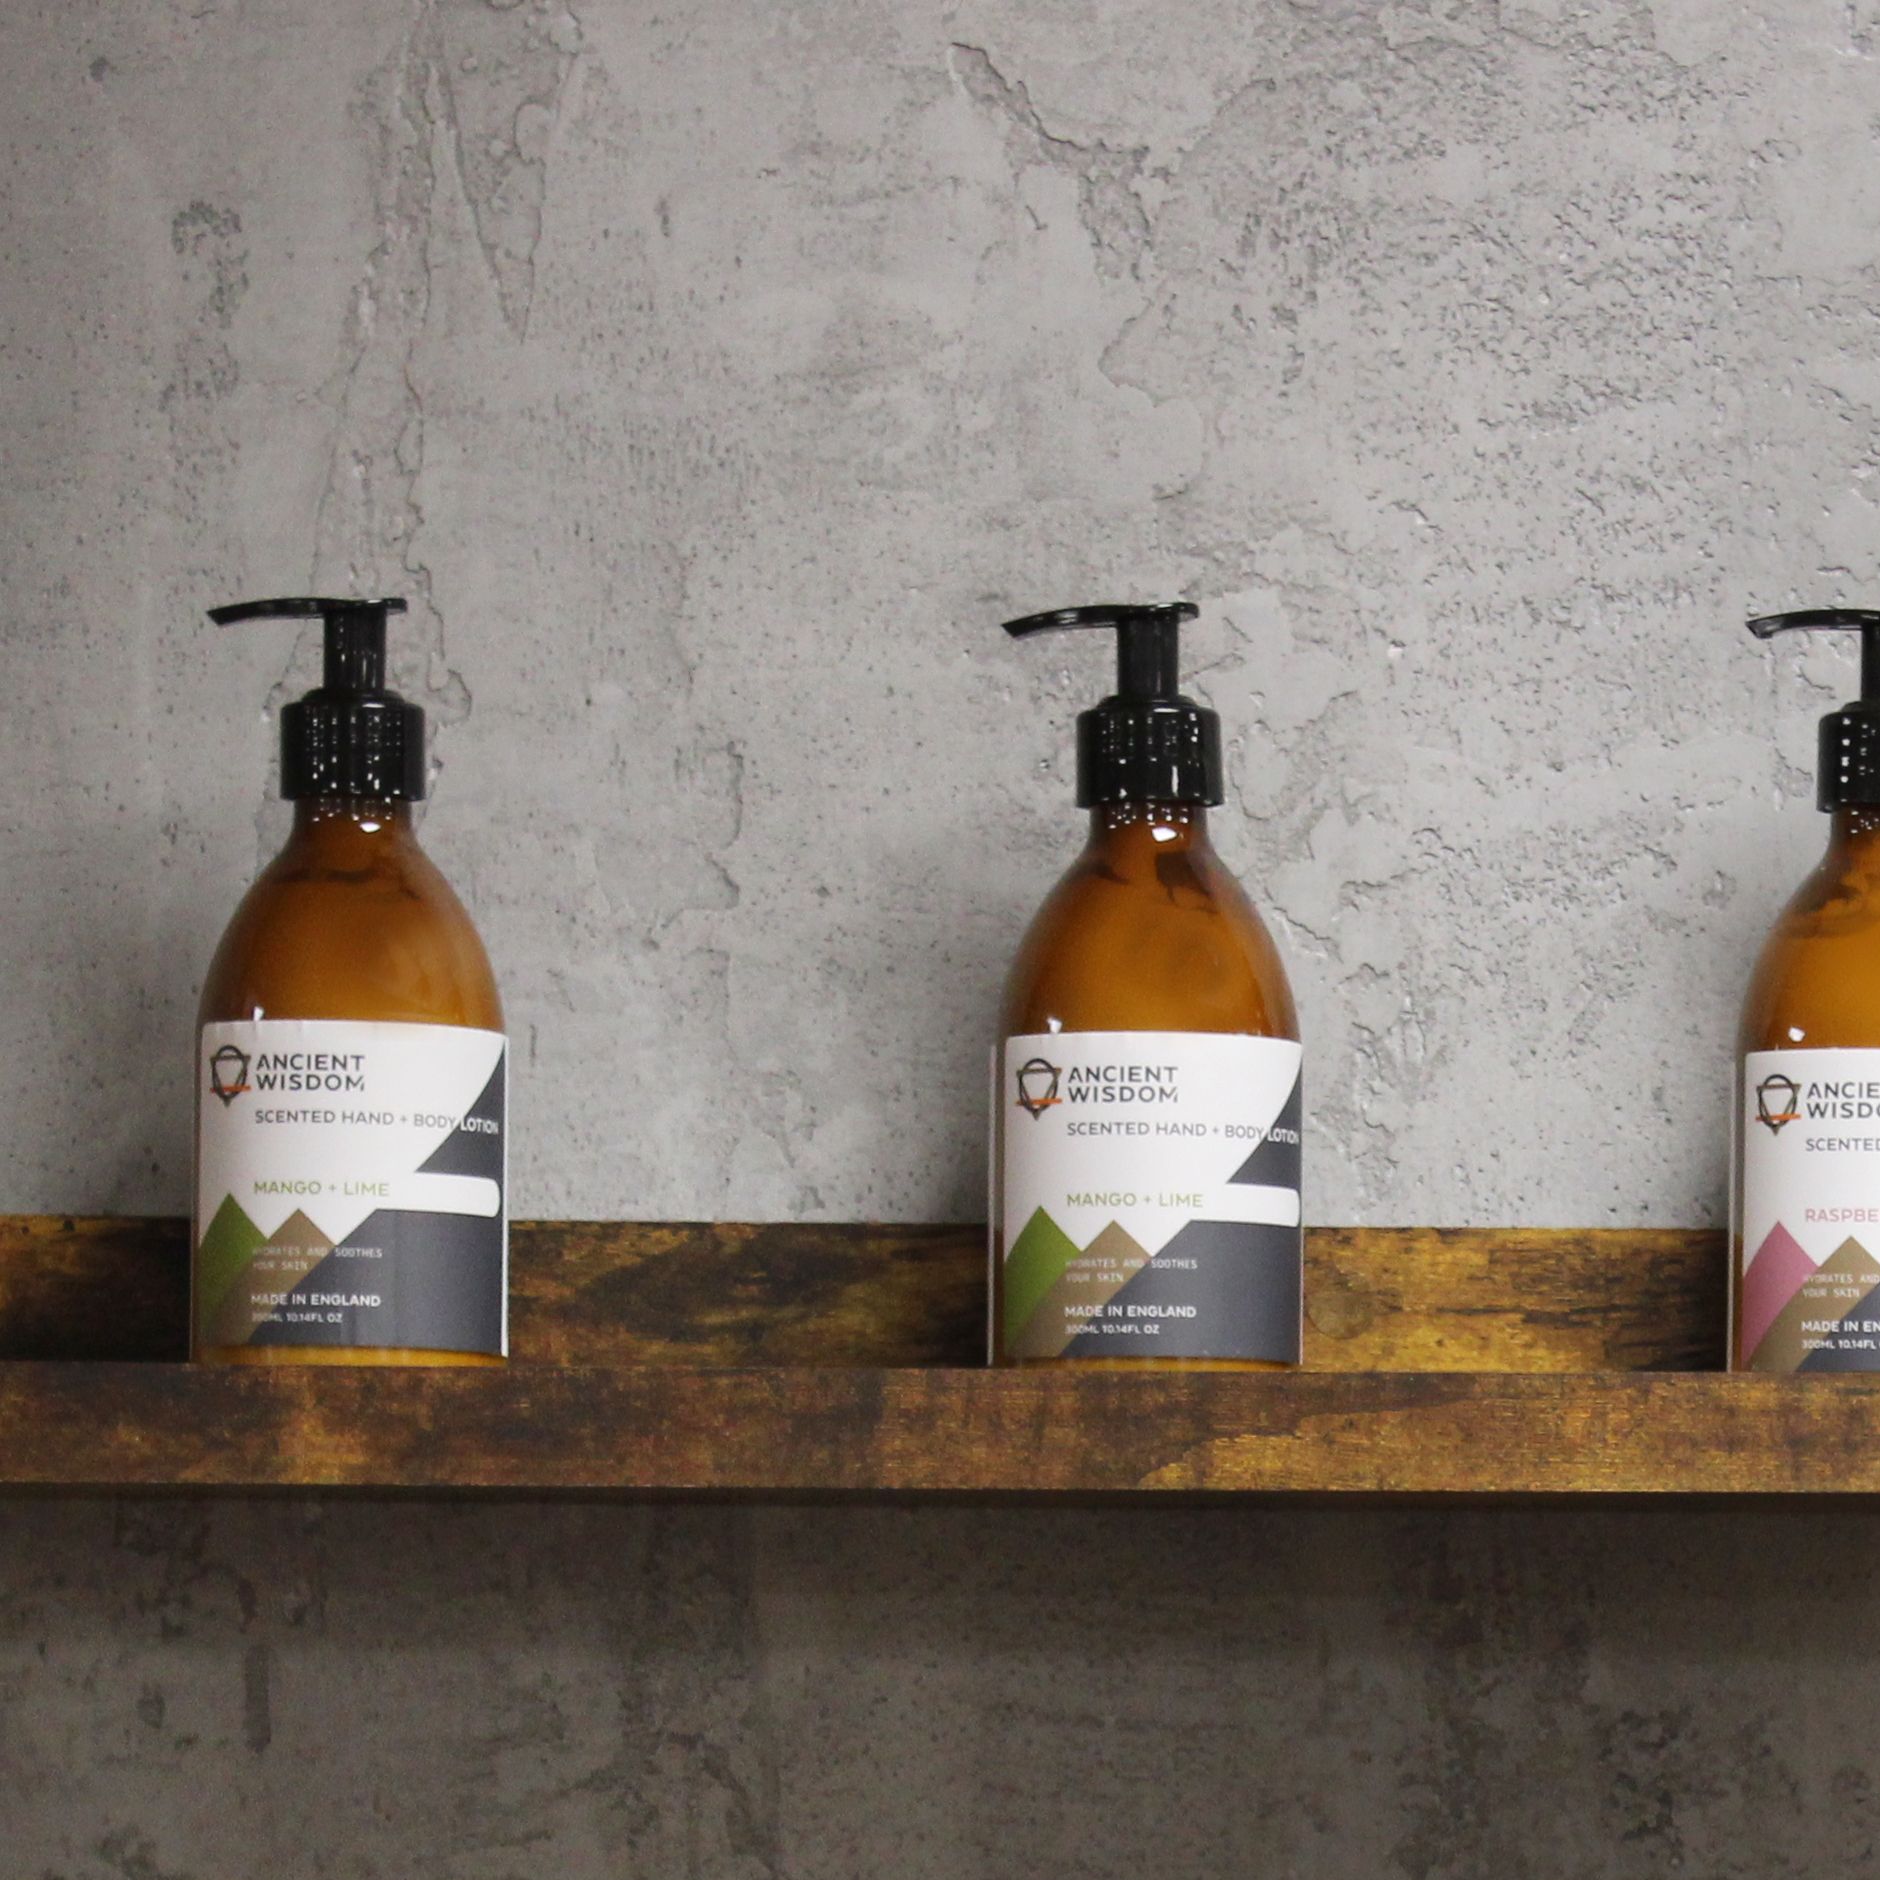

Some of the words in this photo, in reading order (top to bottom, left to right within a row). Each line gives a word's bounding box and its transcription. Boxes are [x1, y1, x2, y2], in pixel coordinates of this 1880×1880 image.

[256, 1054, 366, 1071] ANCIENT
[257, 1074, 365, 1091] WISDOM
[1068, 1066, 1178, 1083] ANCIENT
[1068, 1086, 1178, 1103] WISDOM
[255, 1111, 335, 1124] SCENTED
[342, 1112, 394, 1125] HAND
[414, 1114, 458, 1128] BODY
[1067, 1123, 1150, 1135] SCENTED
[1156, 1123, 1207, 1136] HAND
[1225, 1125, 1264, 1139] BODY
[1267, 1129, 1299, 1144] LOTION
[254, 1181, 322, 1195] MANGO
[344, 1182, 390, 1196] LIME
[1067, 1193, 1136, 1207] MANGO
[1159, 1194, 1202, 1208] LIME
[252, 1295, 287, 1305] MADE
[292, 1295, 306, 1305] IN
[311, 1295, 380, 1306] ENGLAND
[1065, 1306, 1104, 1317] MADE
[1108, 1306, 1122, 1317] IN
[1127, 1307, 1196, 1318] ENGLAND
[1802, 1321, 1839, 1332] MADE
[1844, 1321, 1859, 1332] IN
